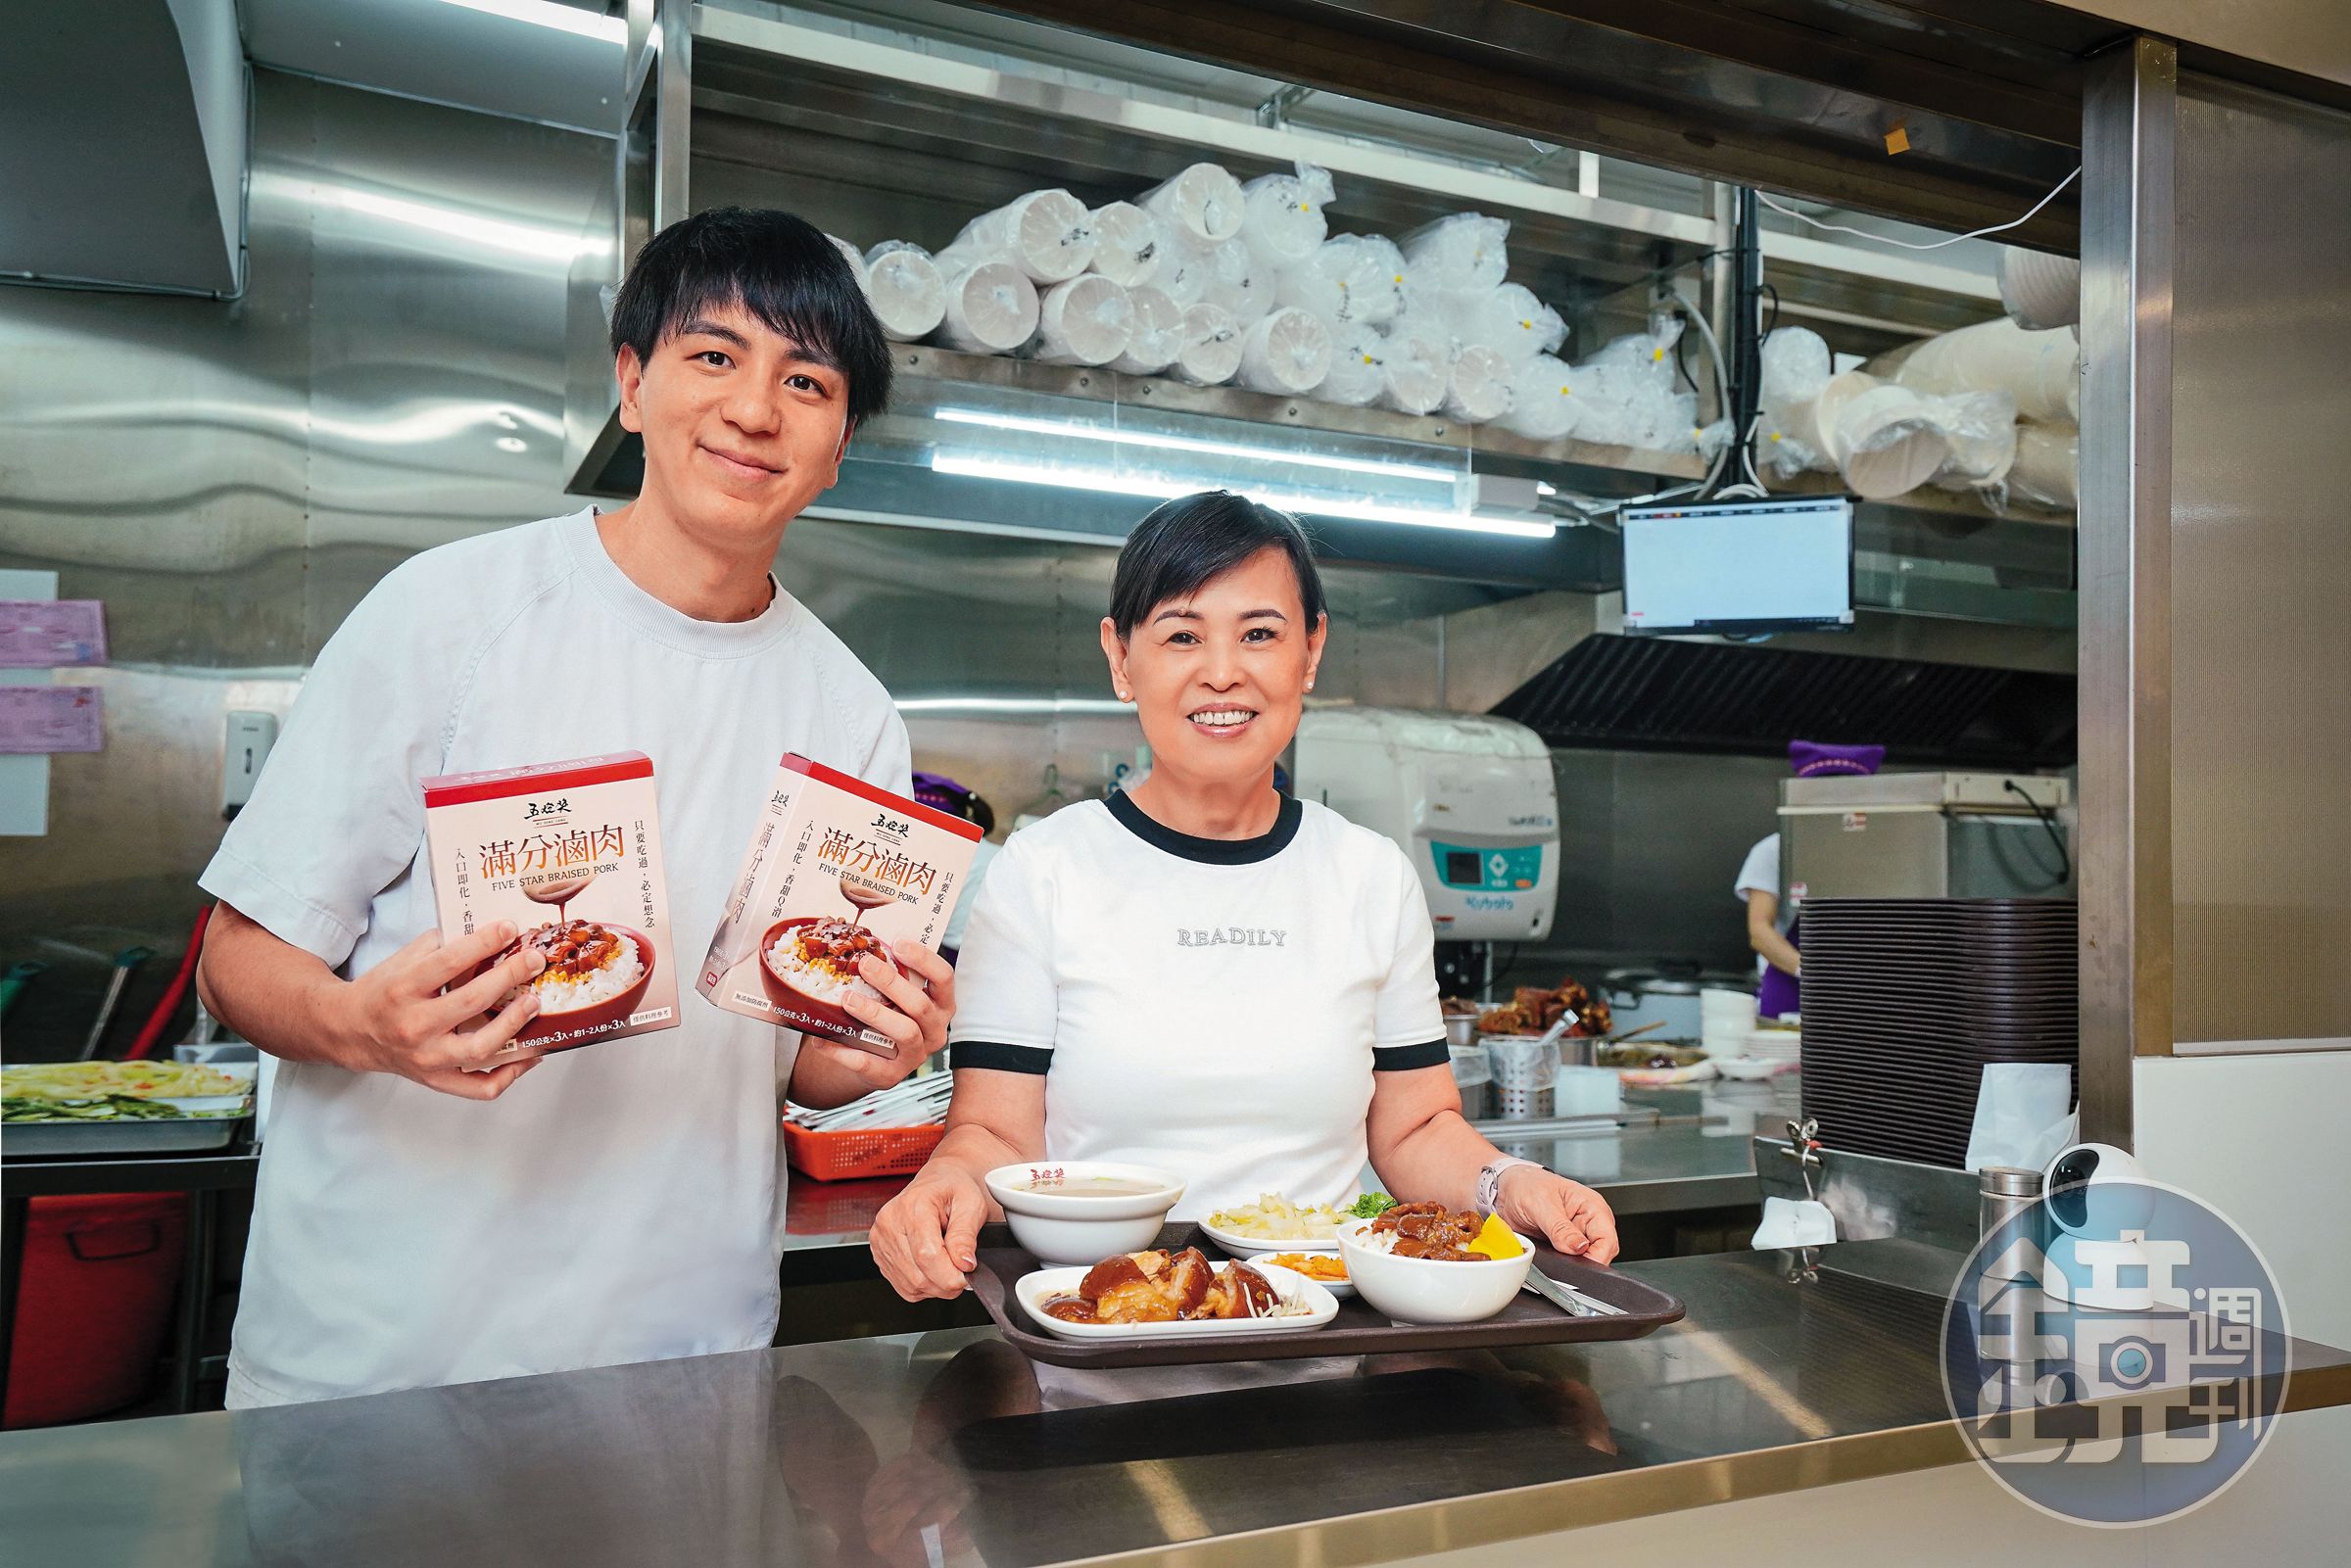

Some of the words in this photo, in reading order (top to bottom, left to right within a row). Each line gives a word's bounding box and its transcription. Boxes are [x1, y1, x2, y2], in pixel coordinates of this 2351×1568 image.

[479, 824, 625, 879] 滿分滷肉
[817, 827, 937, 895] 滿分滷肉
[492, 879, 515, 891] FIVE
[519, 875, 545, 887] STAR
[549, 868, 590, 882] BRAISED
[594, 862, 619, 875] PORK
[819, 863, 839, 877] FIVE
[840, 871, 861, 884] STAR
[861, 879, 895, 896] BRAISED
[897, 891, 919, 905] PORK
[1177, 927, 1287, 947] READILY
